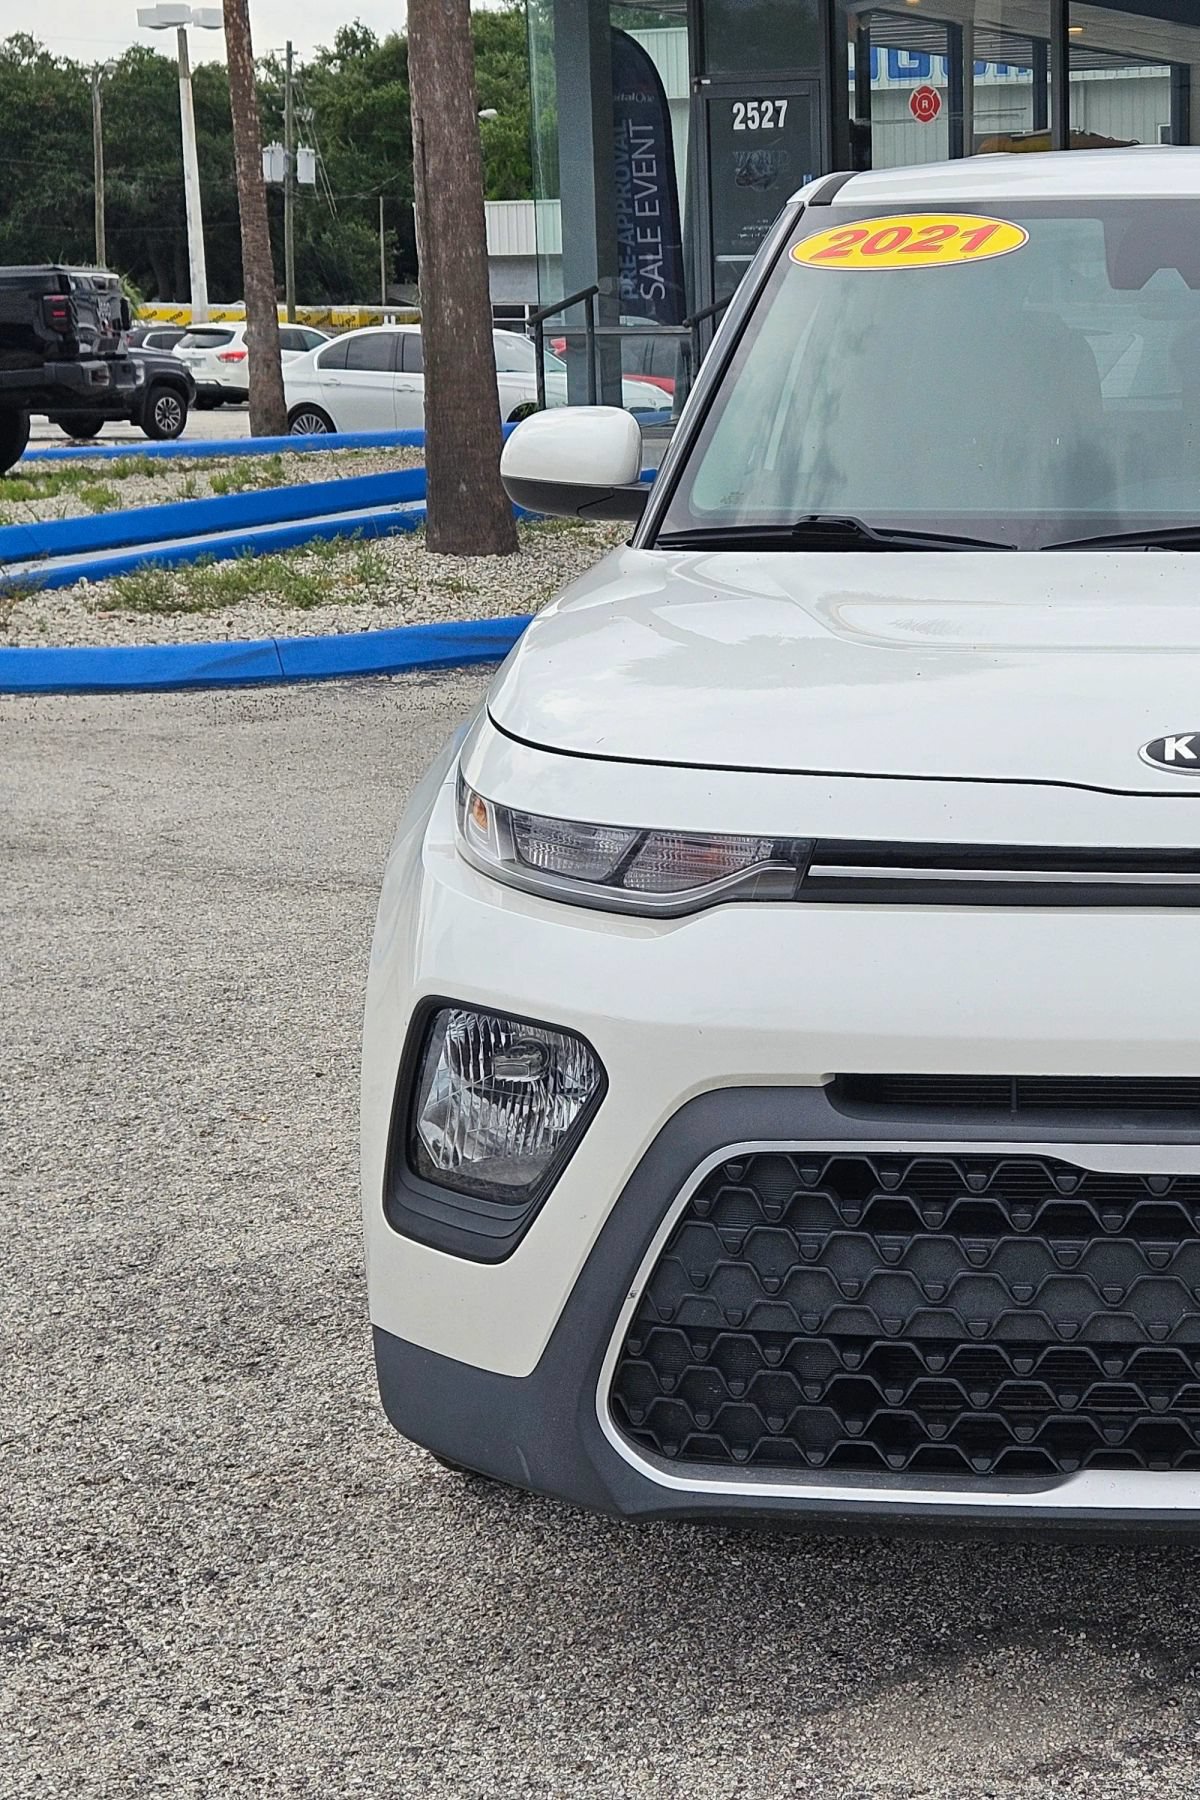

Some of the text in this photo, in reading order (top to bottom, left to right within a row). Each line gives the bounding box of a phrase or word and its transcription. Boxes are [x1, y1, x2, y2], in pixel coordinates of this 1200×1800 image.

[732, 99, 788, 130] 2527
[921, 100, 929, 109] R
[613, 119, 639, 300] PRE-APPROVAL
[628, 118, 666, 300] SALE EVENT
[809, 224, 1002, 261] 2021
